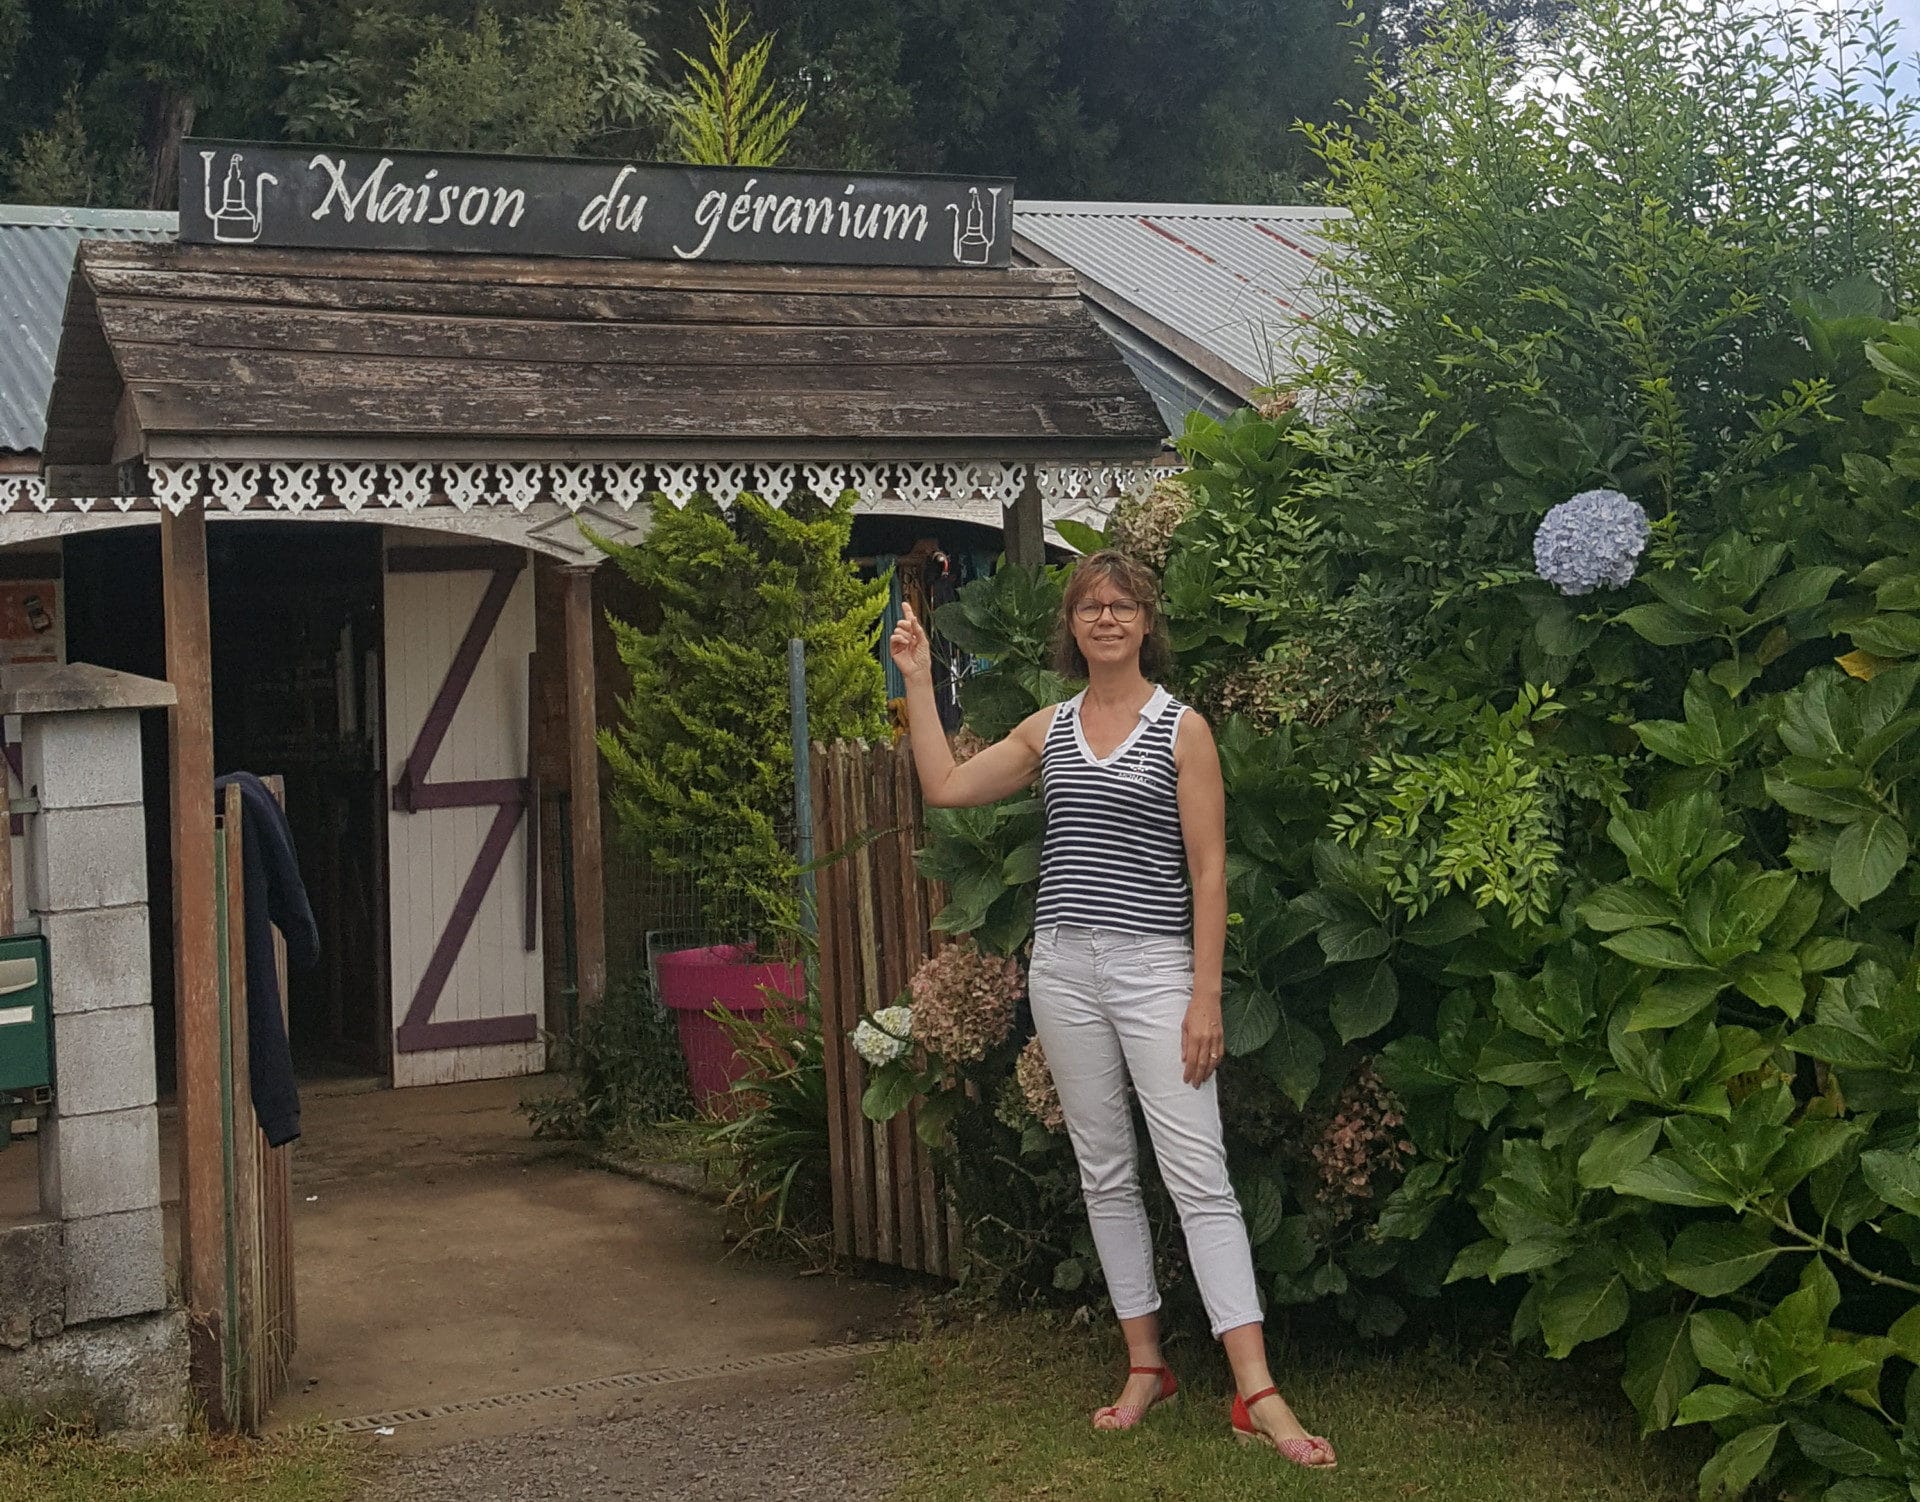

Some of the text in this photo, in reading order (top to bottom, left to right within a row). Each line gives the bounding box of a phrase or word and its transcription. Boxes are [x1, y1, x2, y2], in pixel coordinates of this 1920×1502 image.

[308, 154, 930, 260] Maison du géranium
